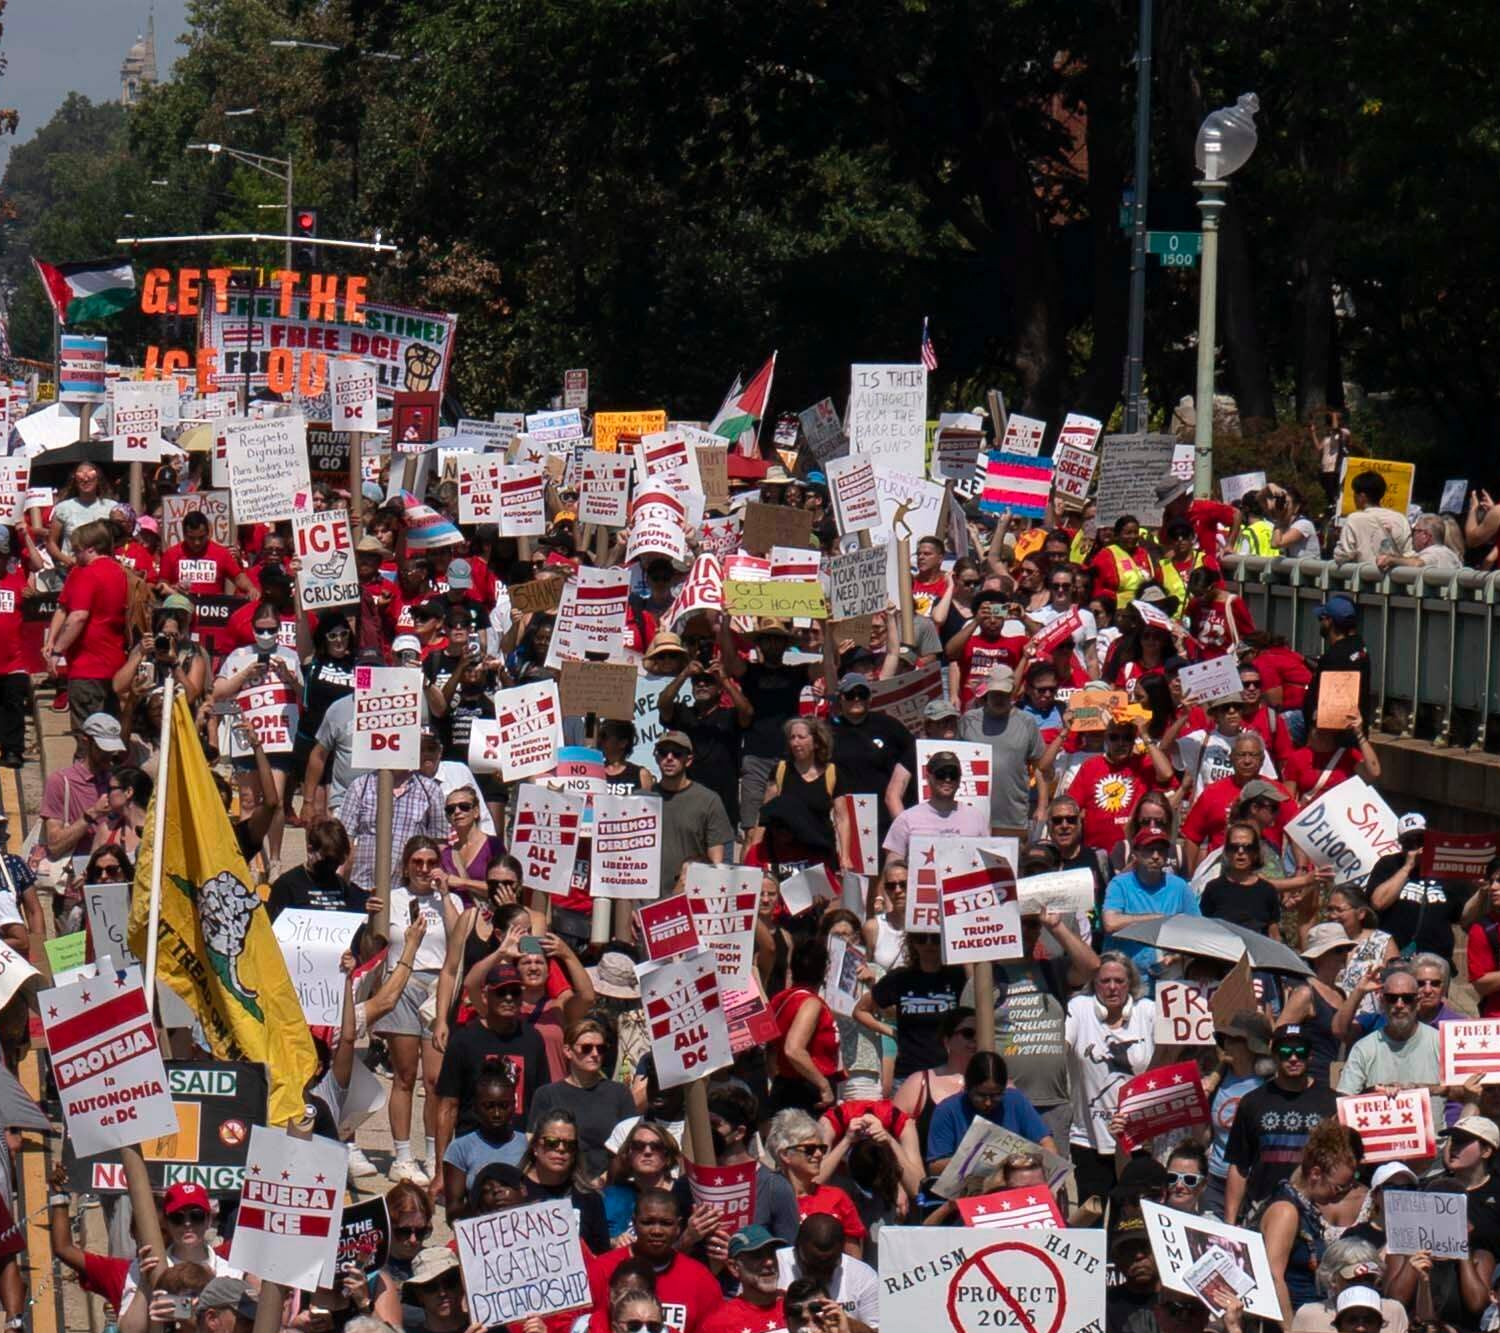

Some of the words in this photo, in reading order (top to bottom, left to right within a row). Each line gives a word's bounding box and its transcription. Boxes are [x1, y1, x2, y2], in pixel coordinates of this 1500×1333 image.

[141, 268, 232, 318] GET
[280, 271, 368, 324] THE
[270, 326, 327, 353] FREE
[351, 336, 399, 361] DC!
[311, 444, 352, 458] MUST
[320, 458, 342, 472] GO
[298, 524, 351, 557] ICE
[303, 584, 361, 604] CRUSHED
[359, 695, 417, 711] TODOS
[359, 714, 417, 730] SOMOS
[371, 734, 401, 752] DC
[248, 1181, 331, 1210] FUERA
[261, 1213, 299, 1236] ICE
[459, 1209, 571, 1260] VETERANS
[481, 1240, 569, 1292] AGAINST
[884, 1249, 971, 1295] RACISM
[1044, 1233, 1101, 1276] HATE
[471, 1272, 590, 1326] DICTATORSHIP
[978, 1309, 1037, 1328] 2025
